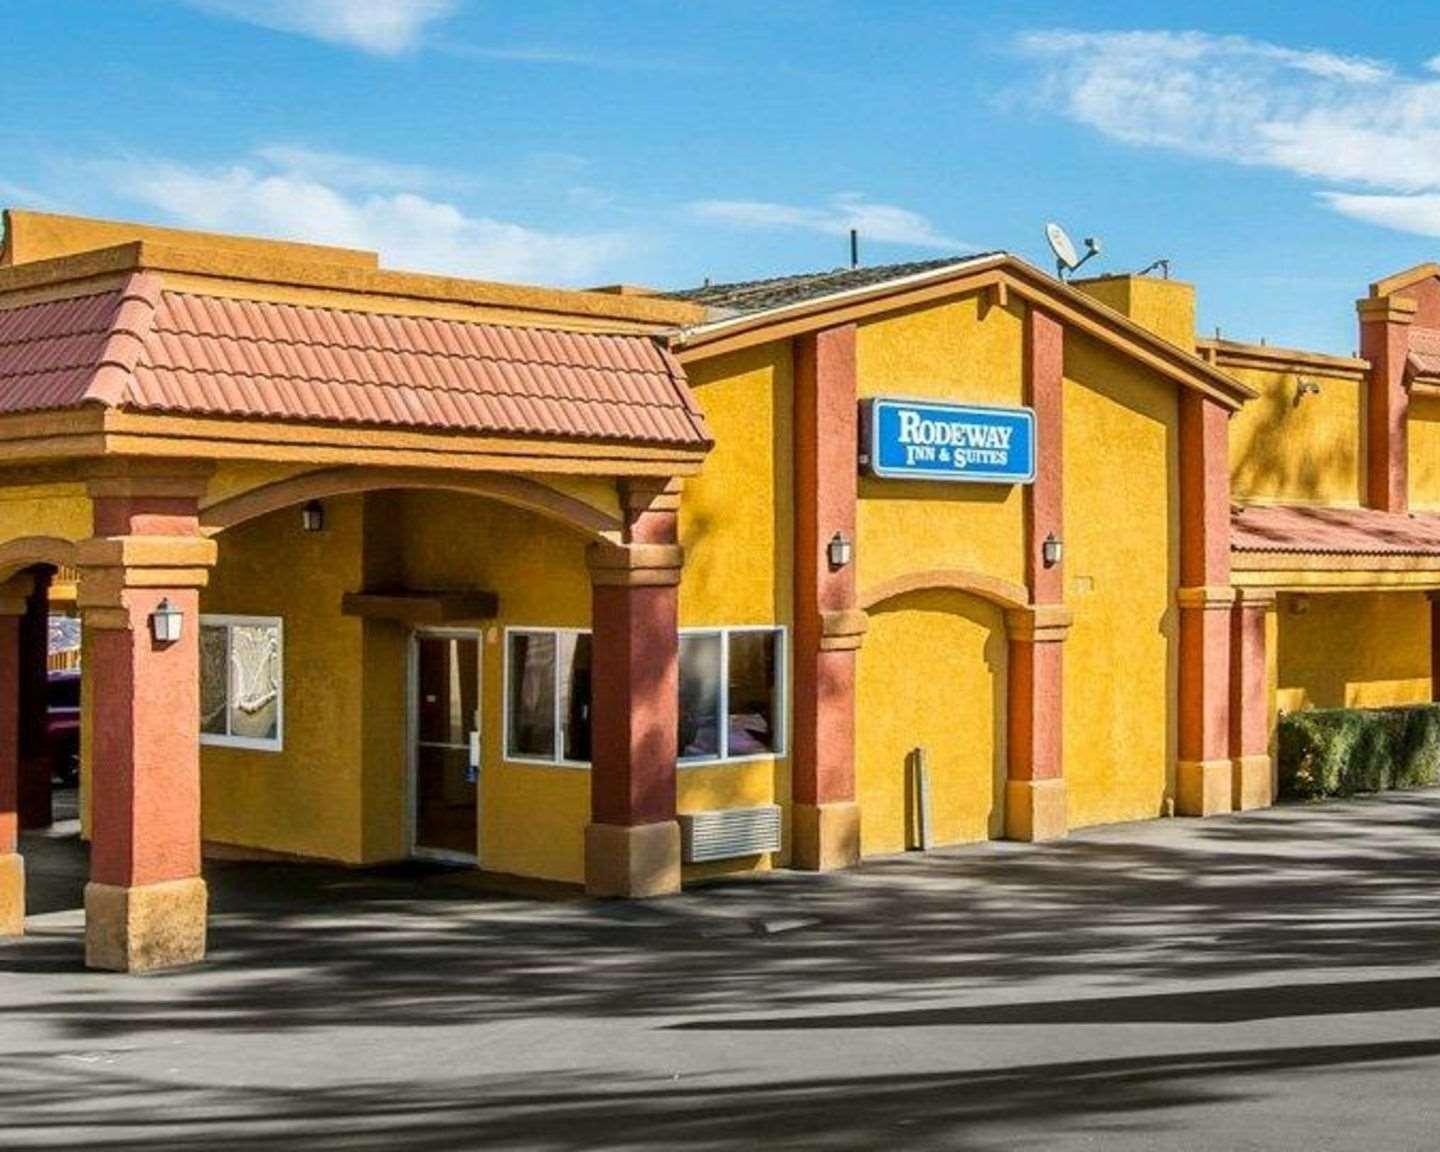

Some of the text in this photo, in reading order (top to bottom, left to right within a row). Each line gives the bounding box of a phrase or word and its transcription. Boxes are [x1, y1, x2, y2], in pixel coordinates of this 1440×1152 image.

[897, 410, 1013, 449] RODEWAY
[906, 445, 1008, 468] INN & SUITES
